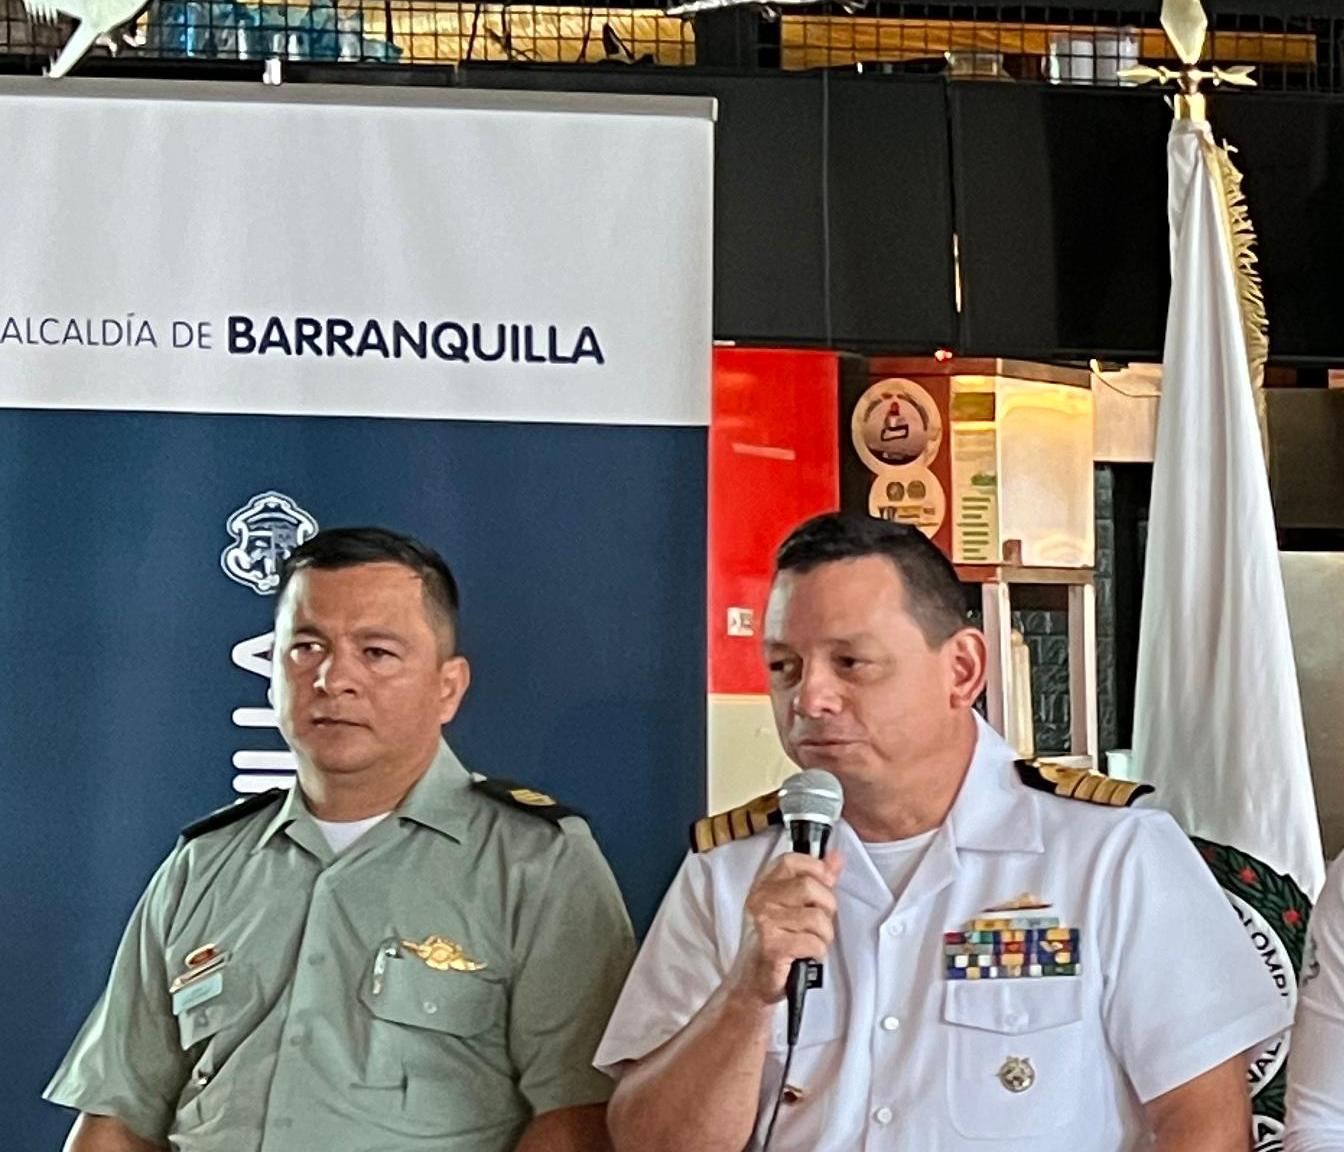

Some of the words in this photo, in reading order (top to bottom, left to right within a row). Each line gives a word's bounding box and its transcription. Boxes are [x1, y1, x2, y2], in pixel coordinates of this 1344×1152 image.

[0, 312, 158, 349] ALCALDÍA
[172, 320, 213, 350] DE
[227, 315, 606, 365] BARRANQUILLA
